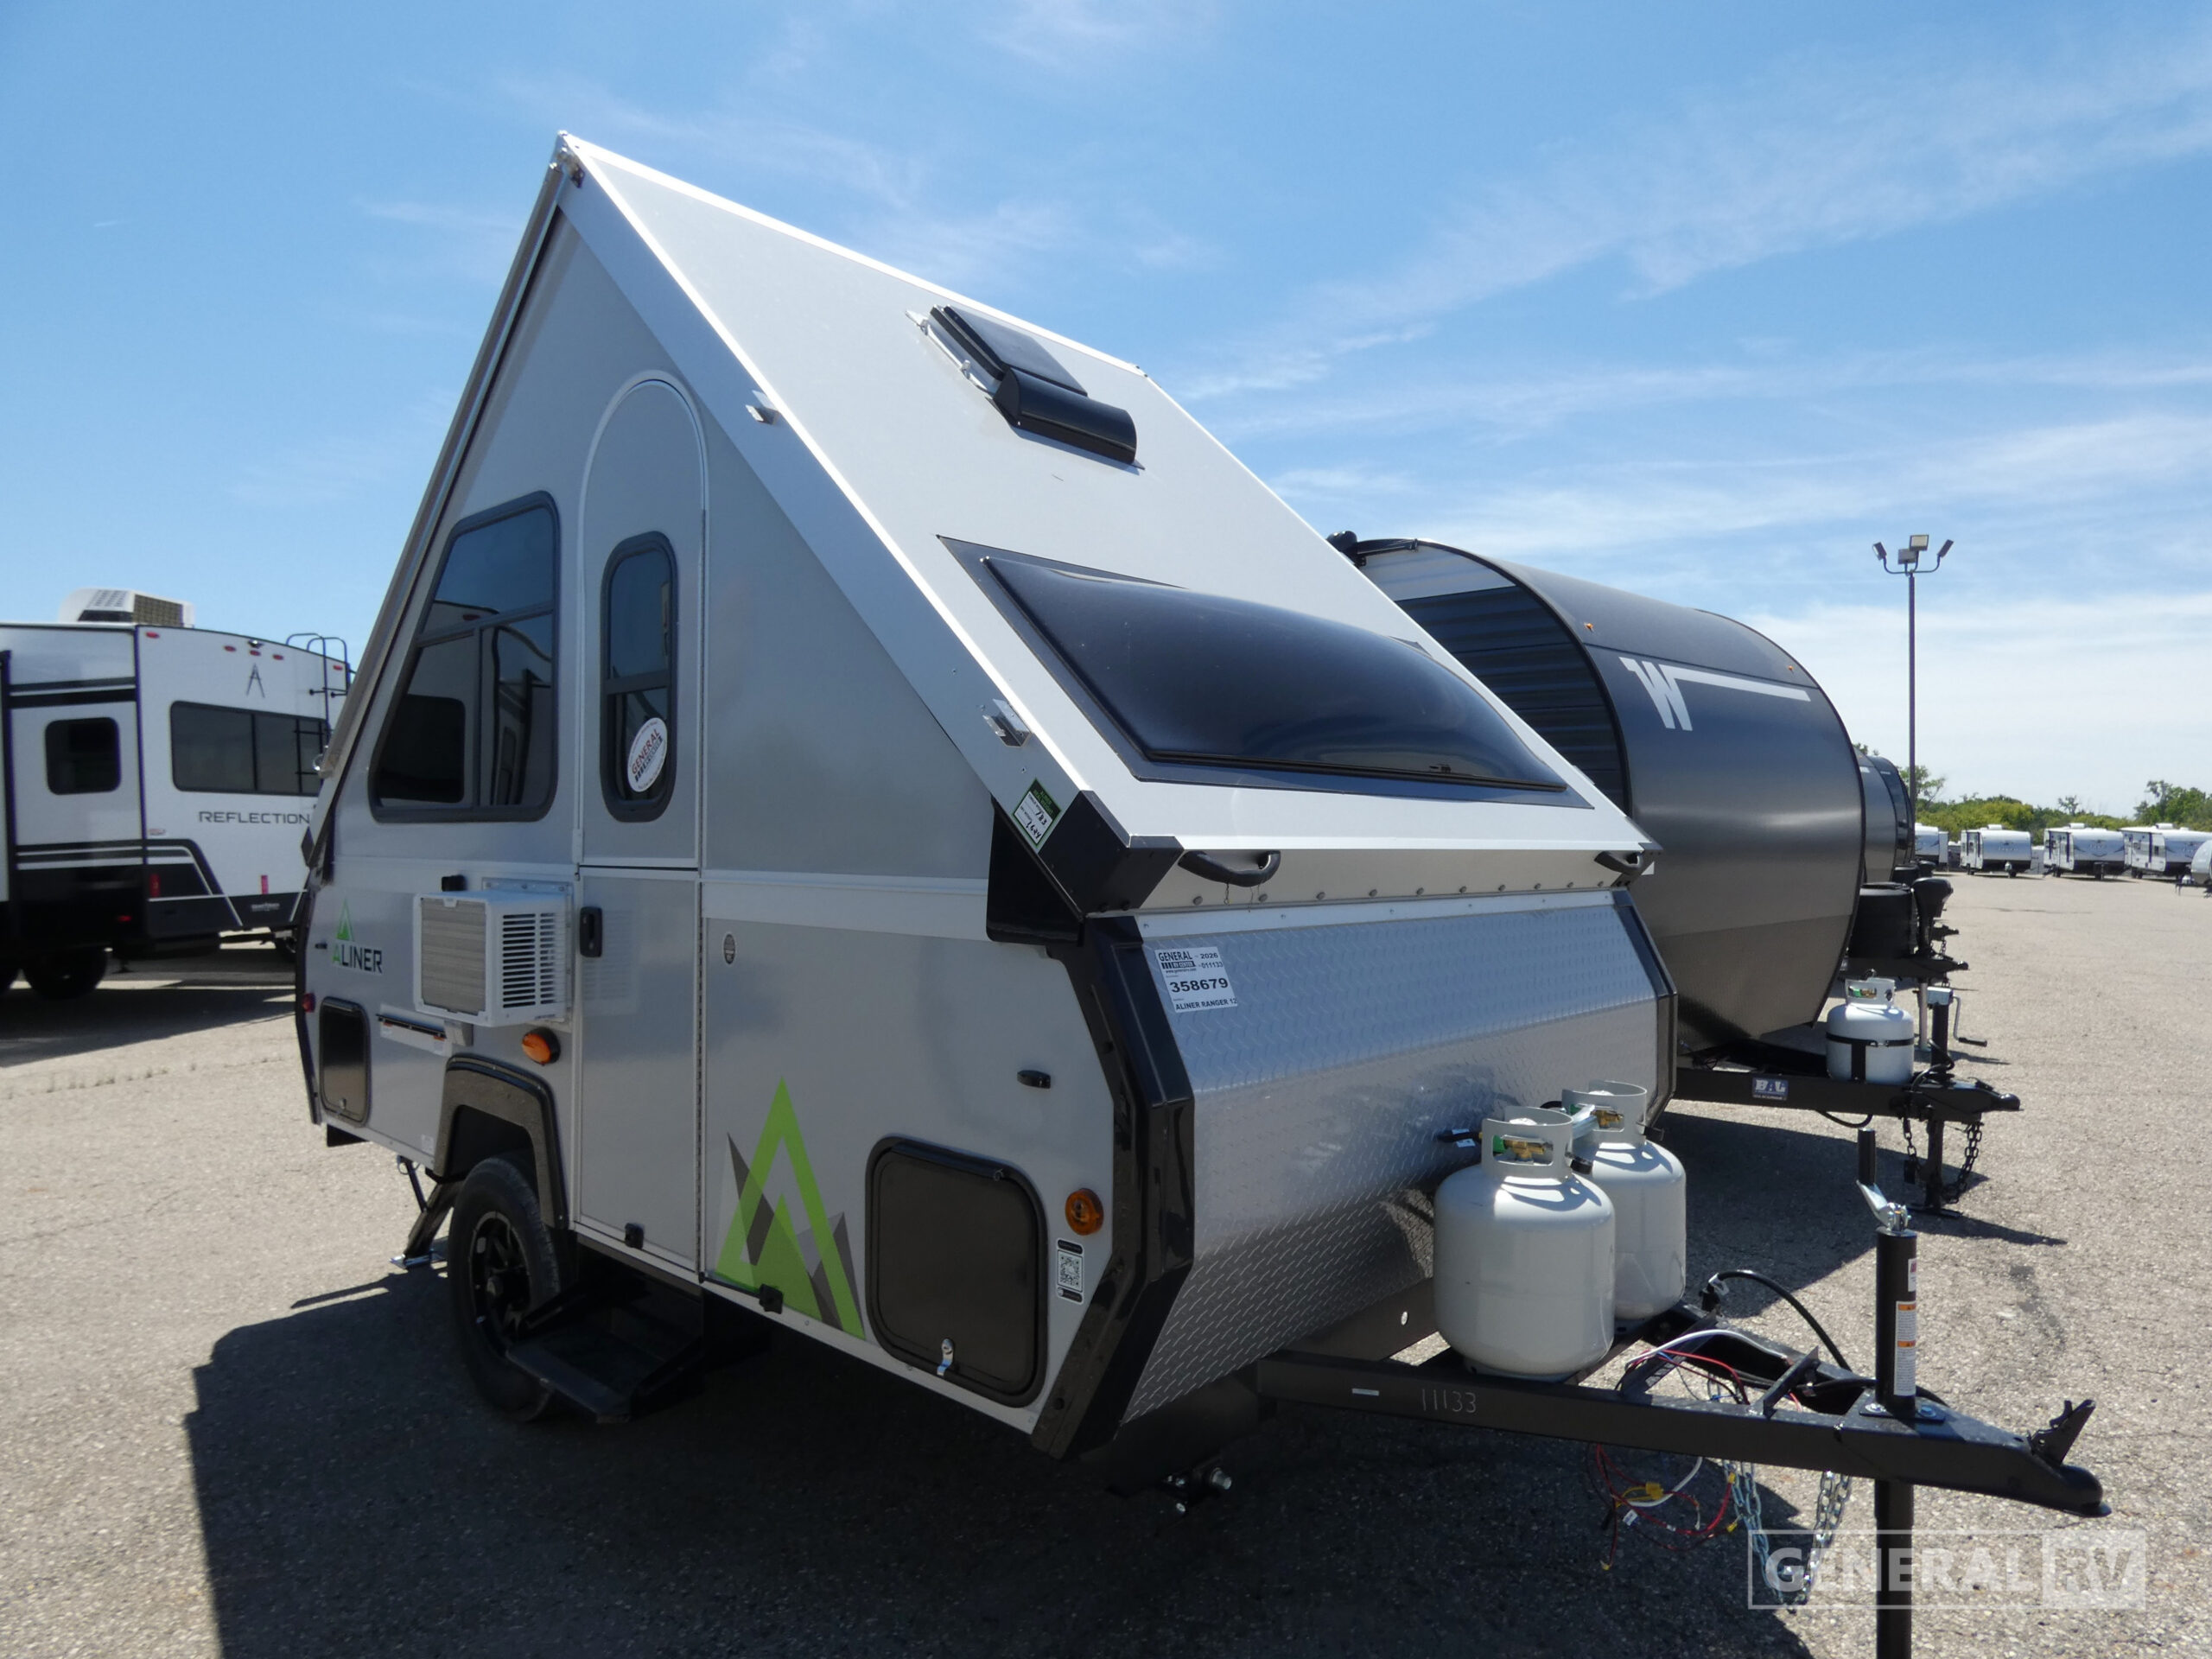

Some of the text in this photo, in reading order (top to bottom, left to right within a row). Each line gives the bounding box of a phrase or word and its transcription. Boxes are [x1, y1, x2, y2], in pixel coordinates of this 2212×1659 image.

[632, 729, 660, 775] GENERAL
[199, 810, 310, 824] REFLECTION
[332, 944, 383, 974] ALINER
[1158, 950, 1192, 962] GENERAL
[1170, 977, 1229, 993] 358679
[1201, 999, 1229, 1007] RANGER
[1421, 1388, 1477, 1414] 11133
